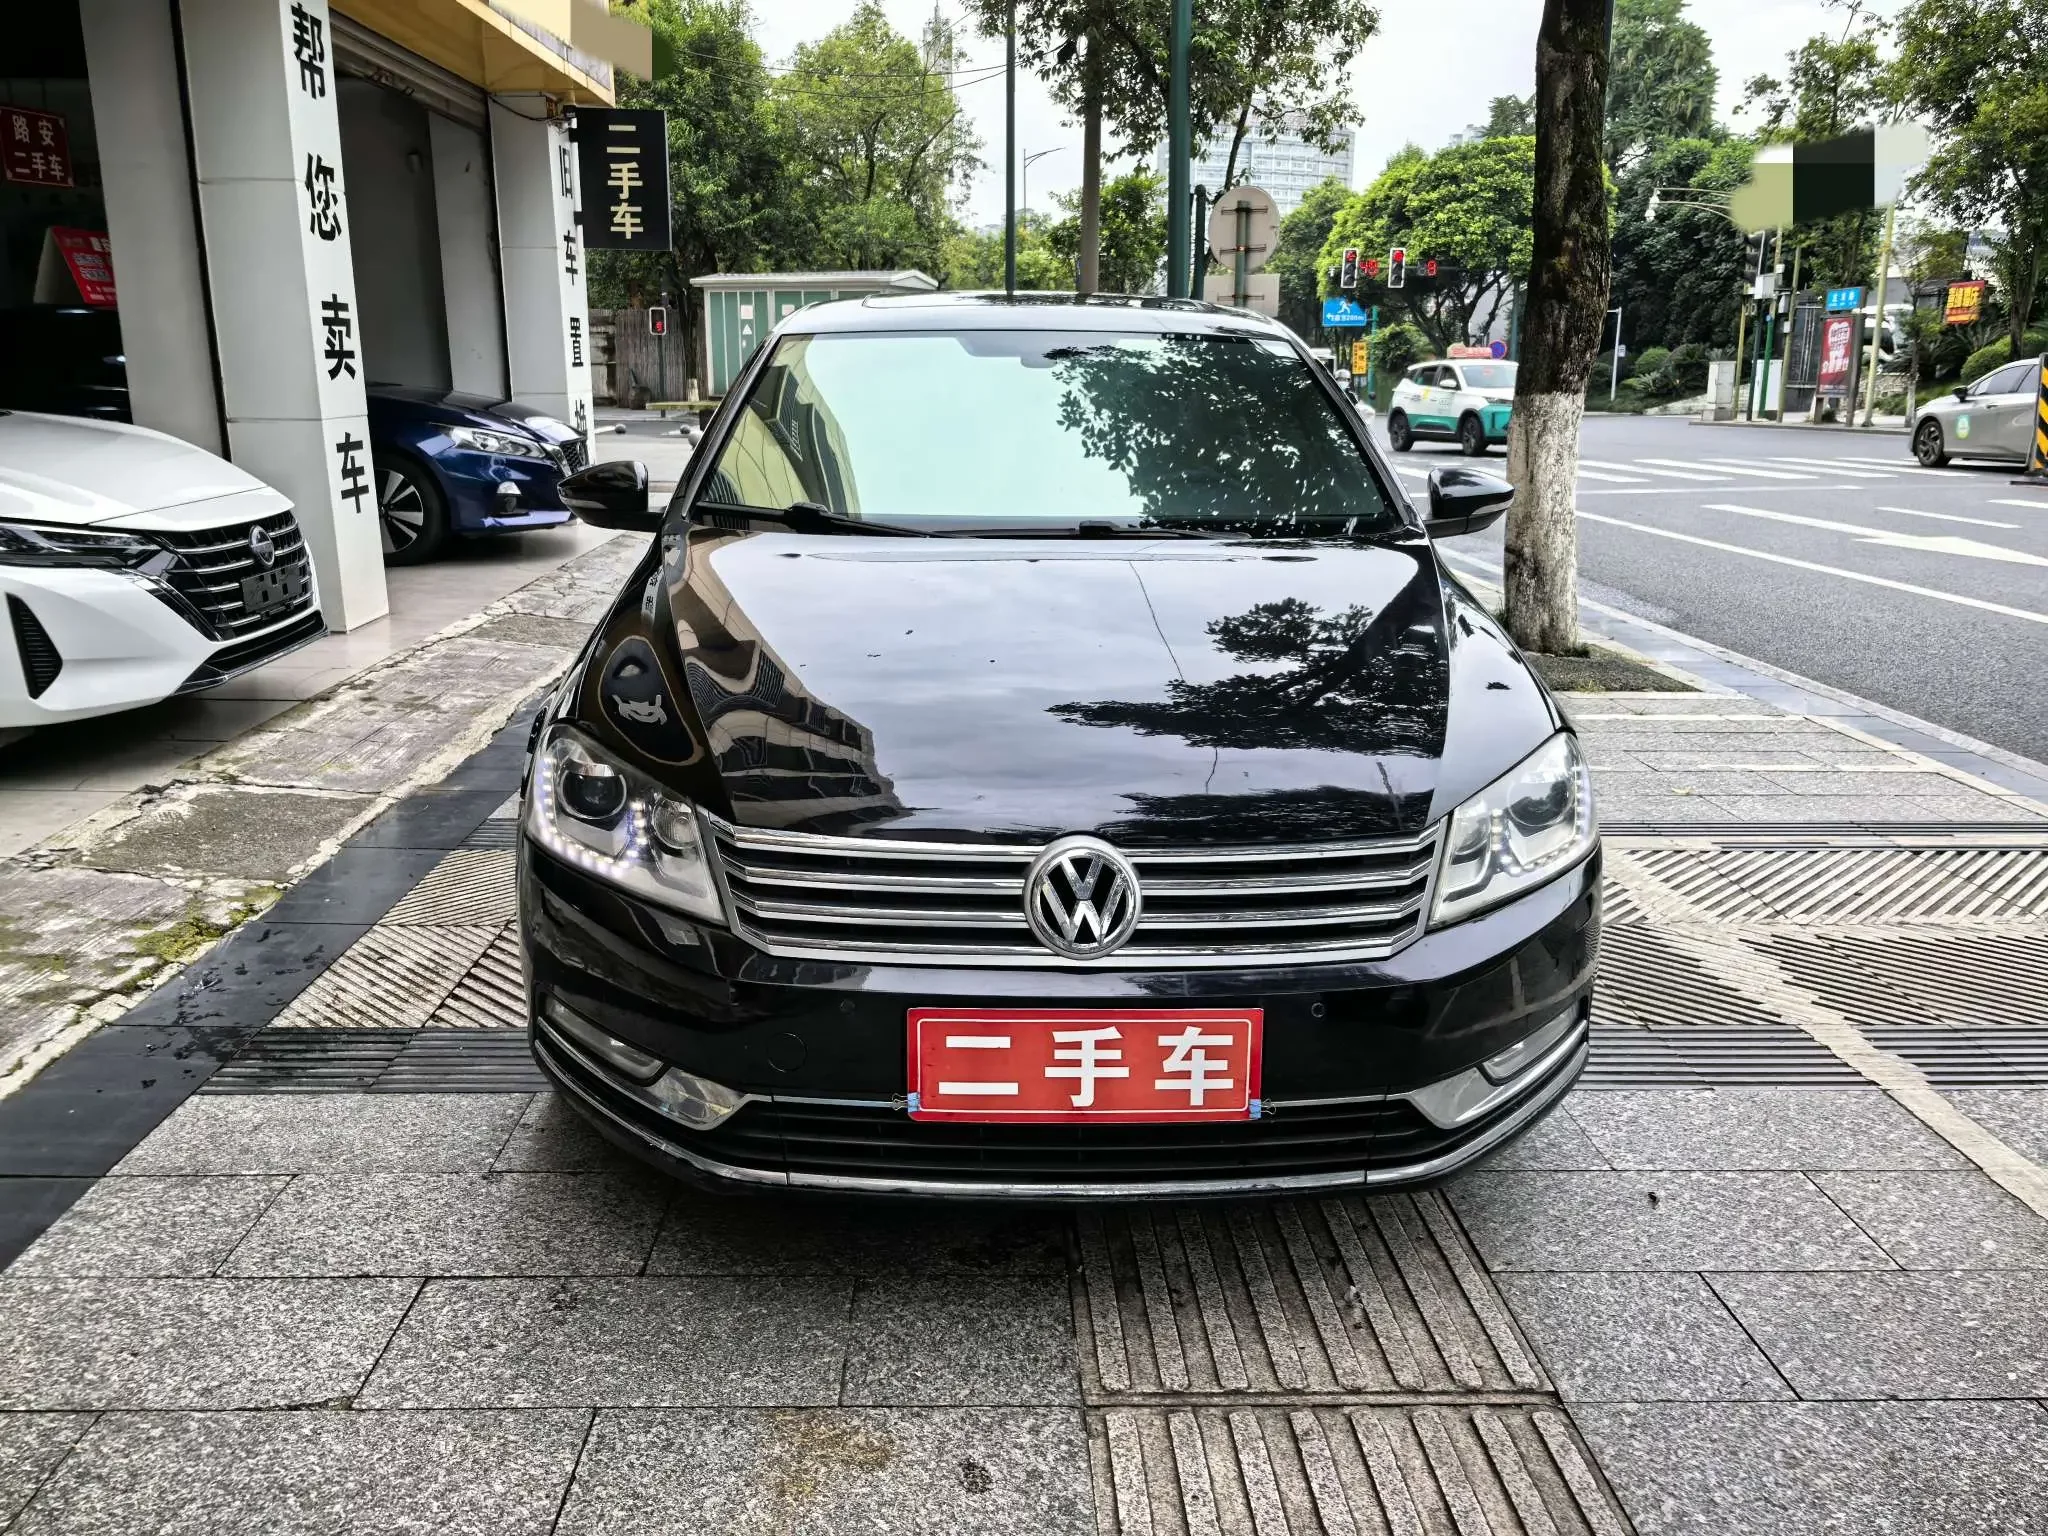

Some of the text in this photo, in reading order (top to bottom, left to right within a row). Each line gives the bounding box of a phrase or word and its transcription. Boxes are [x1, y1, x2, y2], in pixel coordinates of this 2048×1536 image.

[12, 115, 54, 147] 路安
[14, 151, 65, 181] 二手车
[606, 124, 644, 240] 二手车
[290, 2, 370, 514] 帮您卖车
[938, 1025, 1235, 1108] 二手车
